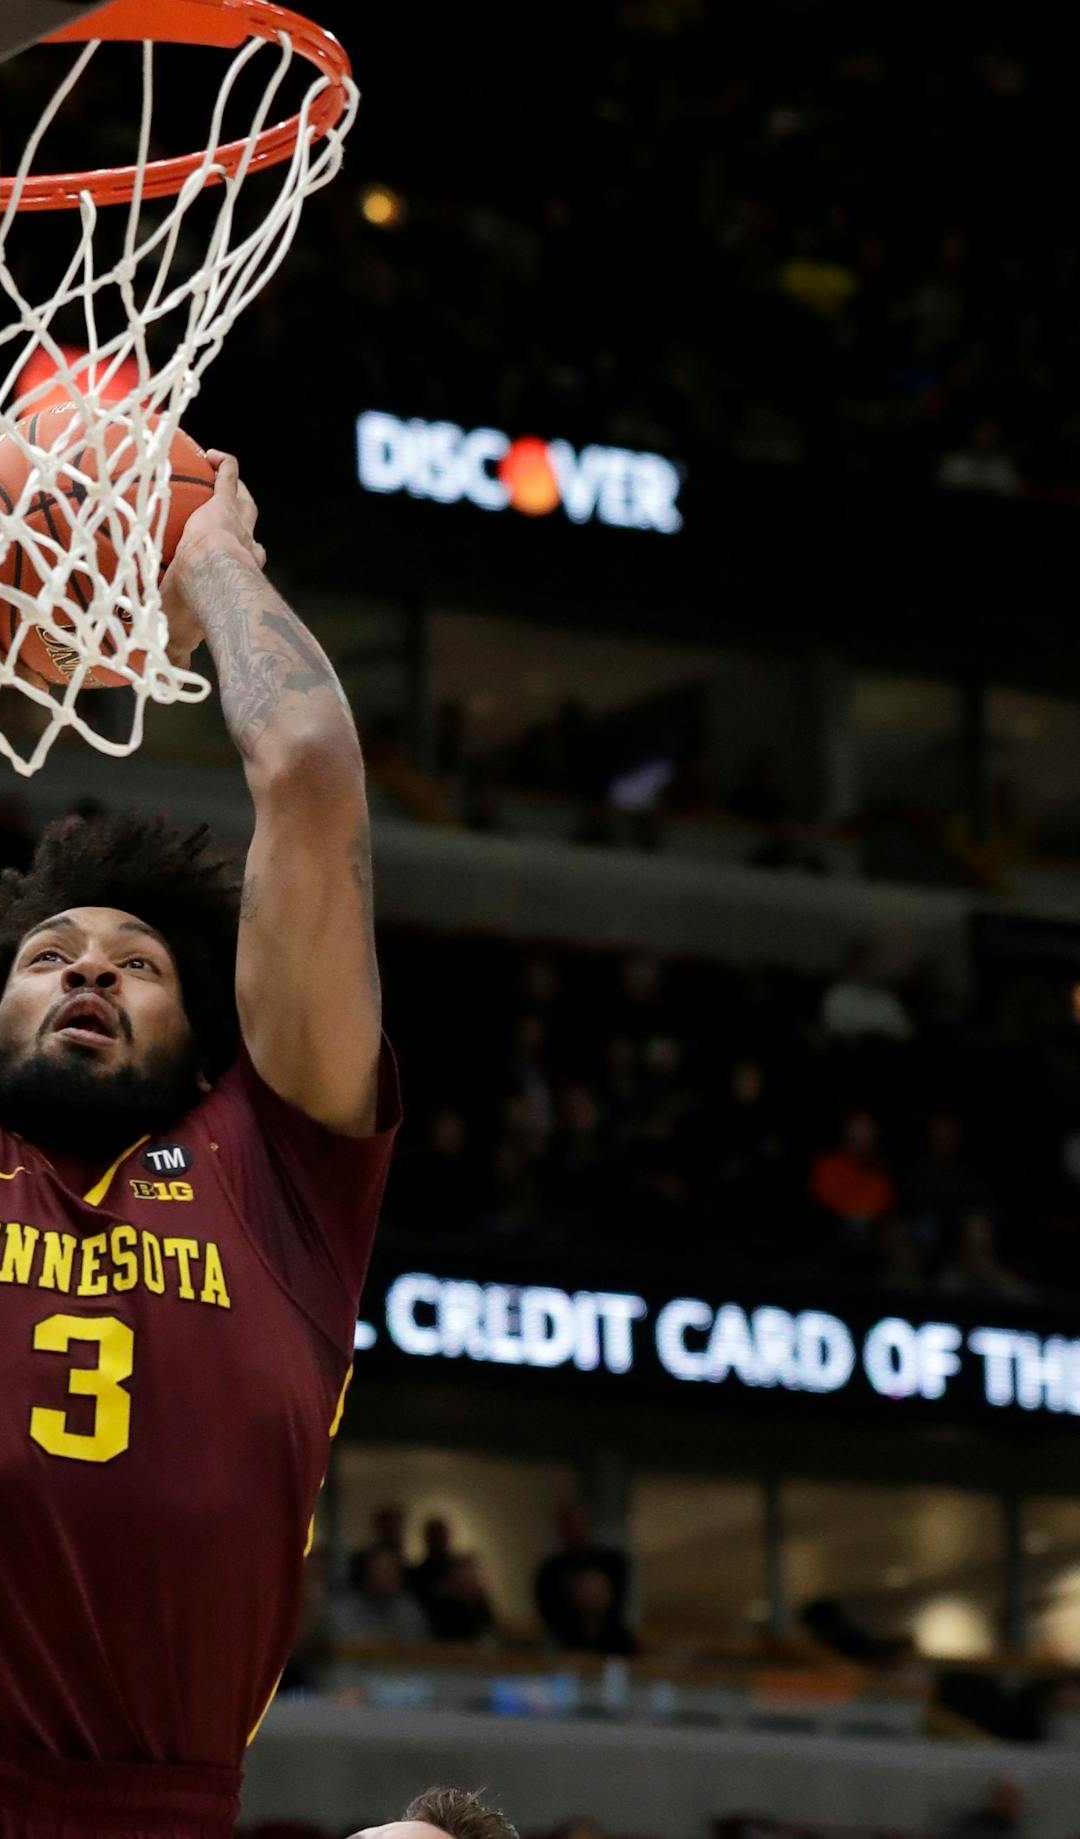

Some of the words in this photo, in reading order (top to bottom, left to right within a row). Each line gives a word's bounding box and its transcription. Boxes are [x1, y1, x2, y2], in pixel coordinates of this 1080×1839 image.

[356, 410, 682, 534] DISCOVER
[146, 1147, 186, 1171] TM
[30, 1313, 134, 1463] 3
[385, 1272, 647, 1375] CREDIT
[655, 1297, 856, 1394] CARD
[863, 1316, 963, 1400] OF
[967, 1326, 1080, 1416] TH
